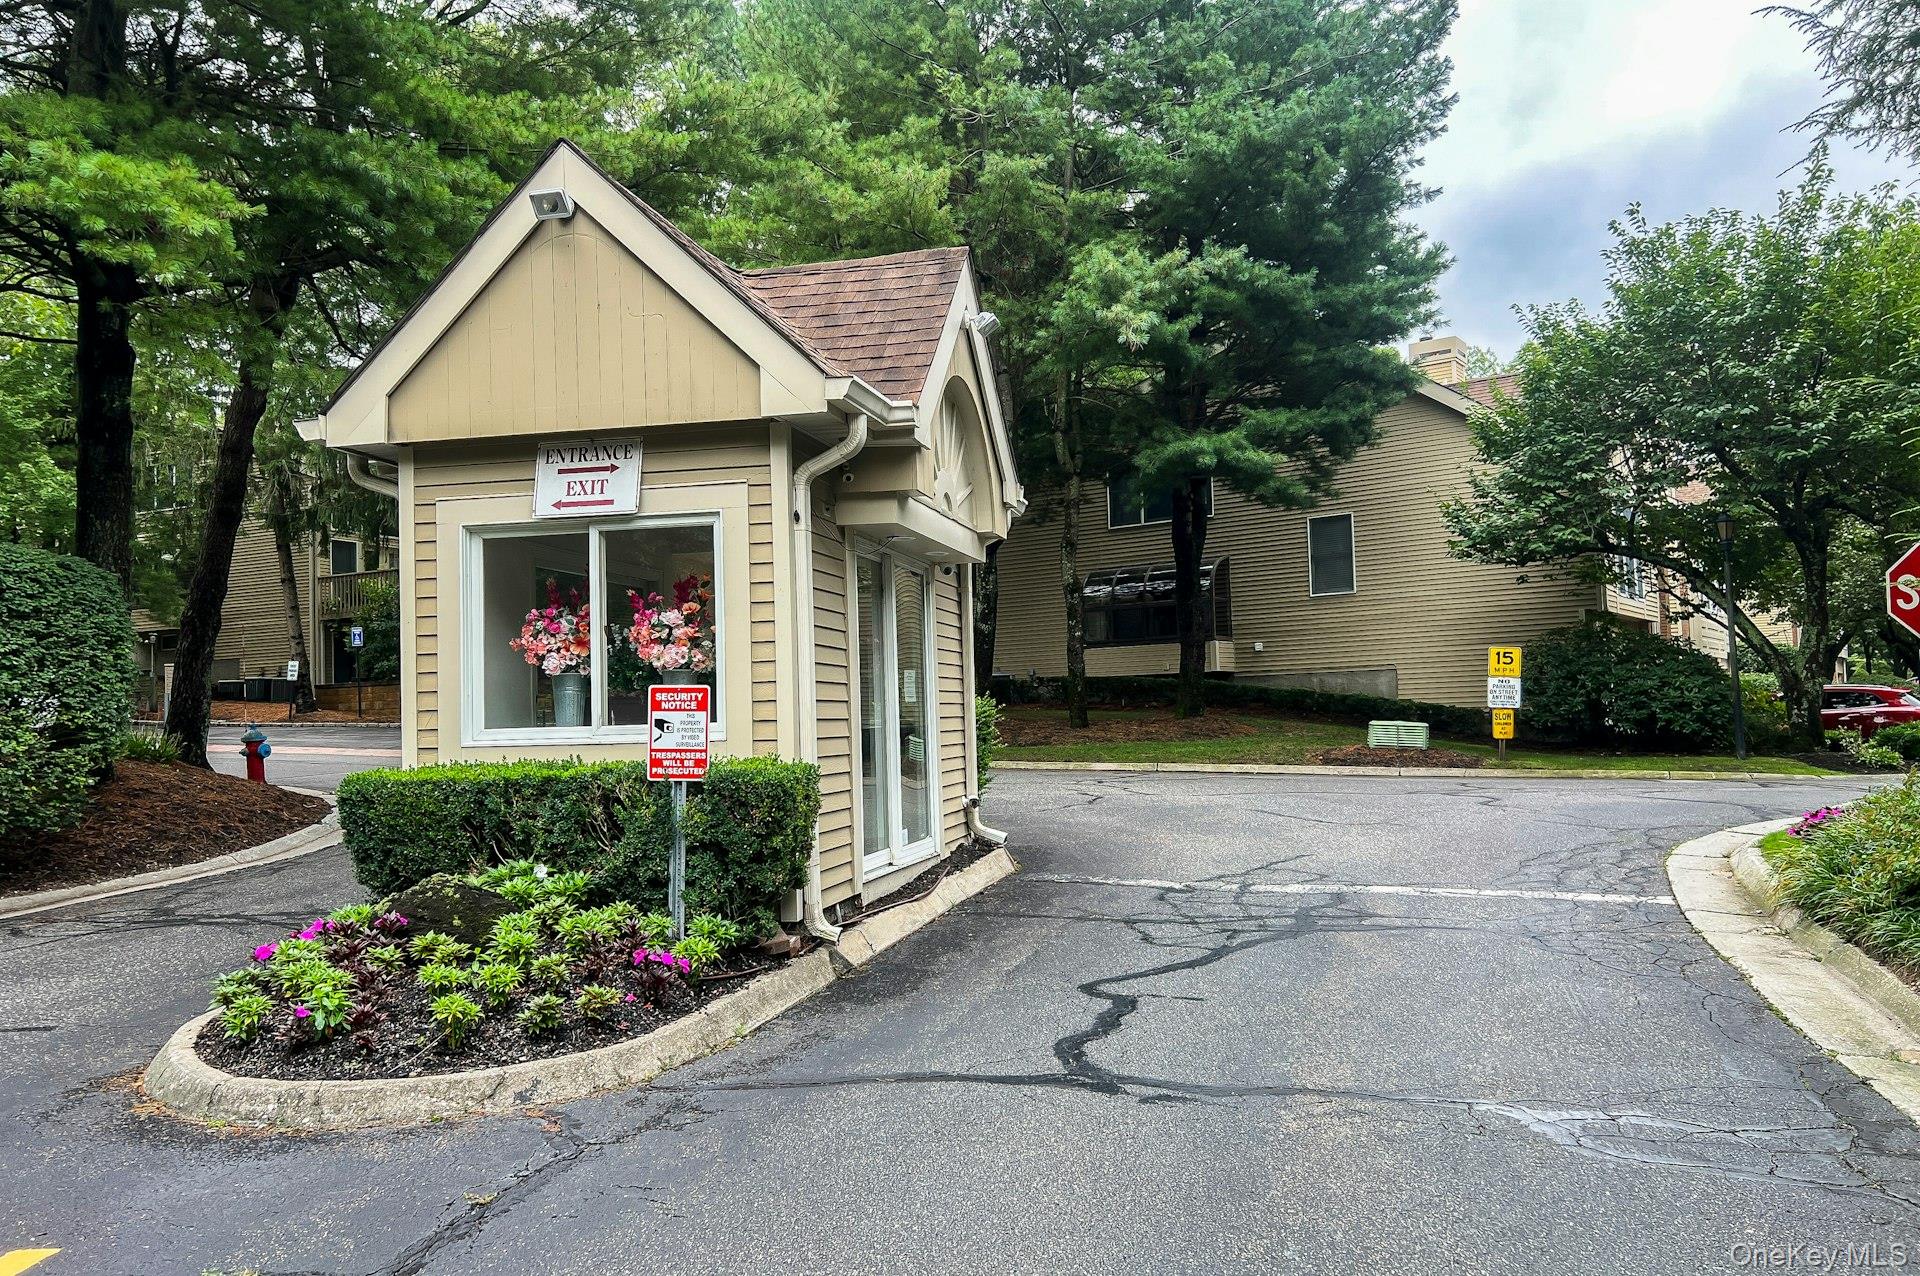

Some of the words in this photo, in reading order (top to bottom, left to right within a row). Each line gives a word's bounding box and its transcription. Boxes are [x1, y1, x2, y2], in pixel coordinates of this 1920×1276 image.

[545, 444, 634, 464] ENTRANCE
[565, 479, 609, 496] EXIT
[1496, 651, 1514, 665] 15
[655, 692, 704, 701] SECURITY
[661, 701, 697, 709] NOTICE
[1494, 712, 1512, 720] SLOW
[651, 751, 707, 760] TRESPASSERS
[662, 759, 682, 767] WILL
[683, 759, 695, 767] BE
[651, 767, 705, 775] PROSECUTED
